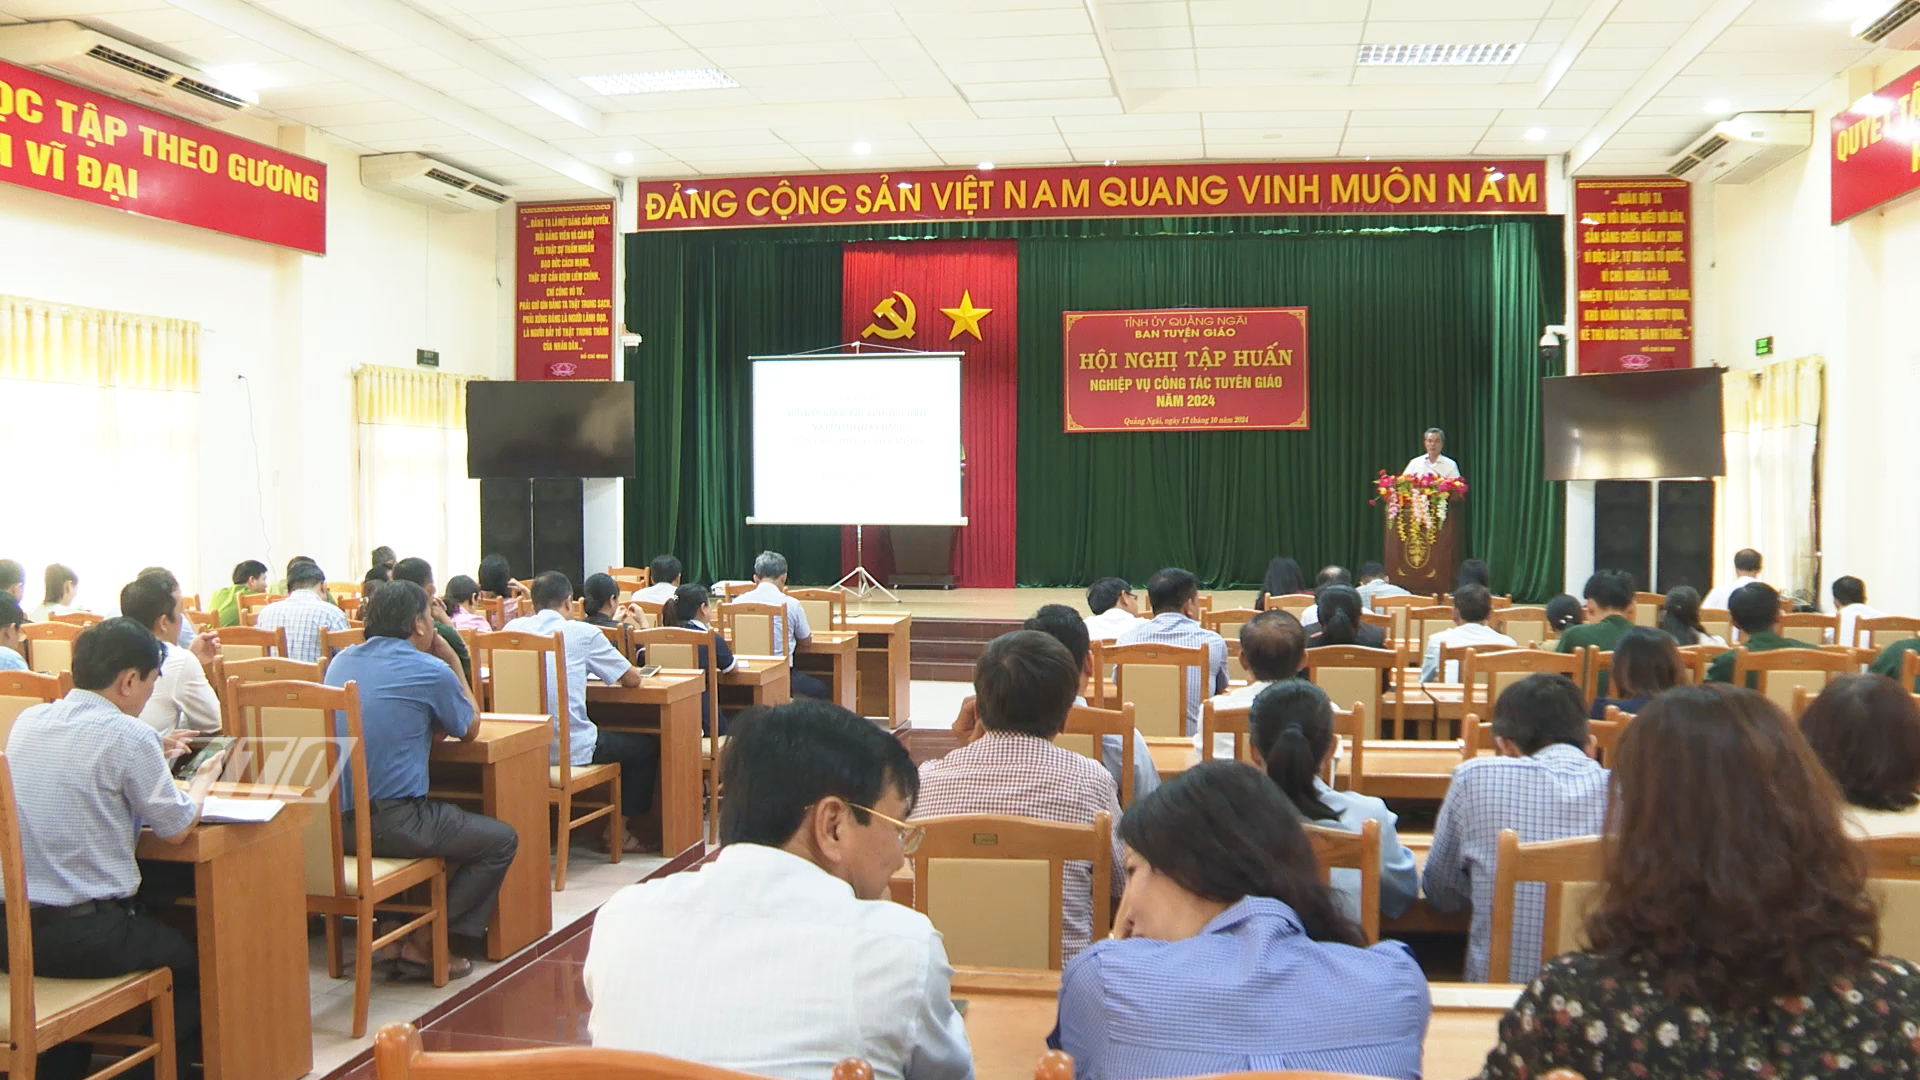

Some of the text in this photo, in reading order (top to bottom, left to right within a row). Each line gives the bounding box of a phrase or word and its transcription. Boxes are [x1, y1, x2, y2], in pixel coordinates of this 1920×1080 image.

[55, 99, 128, 148] TẬP
[138, 123, 219, 175] THEO
[228, 153, 319, 203] GƯƠNG
[25, 139, 67, 181] VĨ
[76, 154, 138, 202] ĐẠI
[645, 165, 1538, 222] ĐẢNG CỘNG SẢN VIỆT NAM QUANG VINH MUÔN NĂM
[1124, 315, 1247, 328] TỈNH ỦY QUẢNG NGÃI
[1135, 327, 1236, 339] BAN TUYÊN GIÁO
[1079, 341, 1293, 373] HỘI NGHỊ TẬP HUẤN
[1090, 376, 1282, 393] NGHIỆP VỤ CÔNG TÁC TUYÊN GIÁO
[1156, 394, 1215, 407] NĂM 2024
